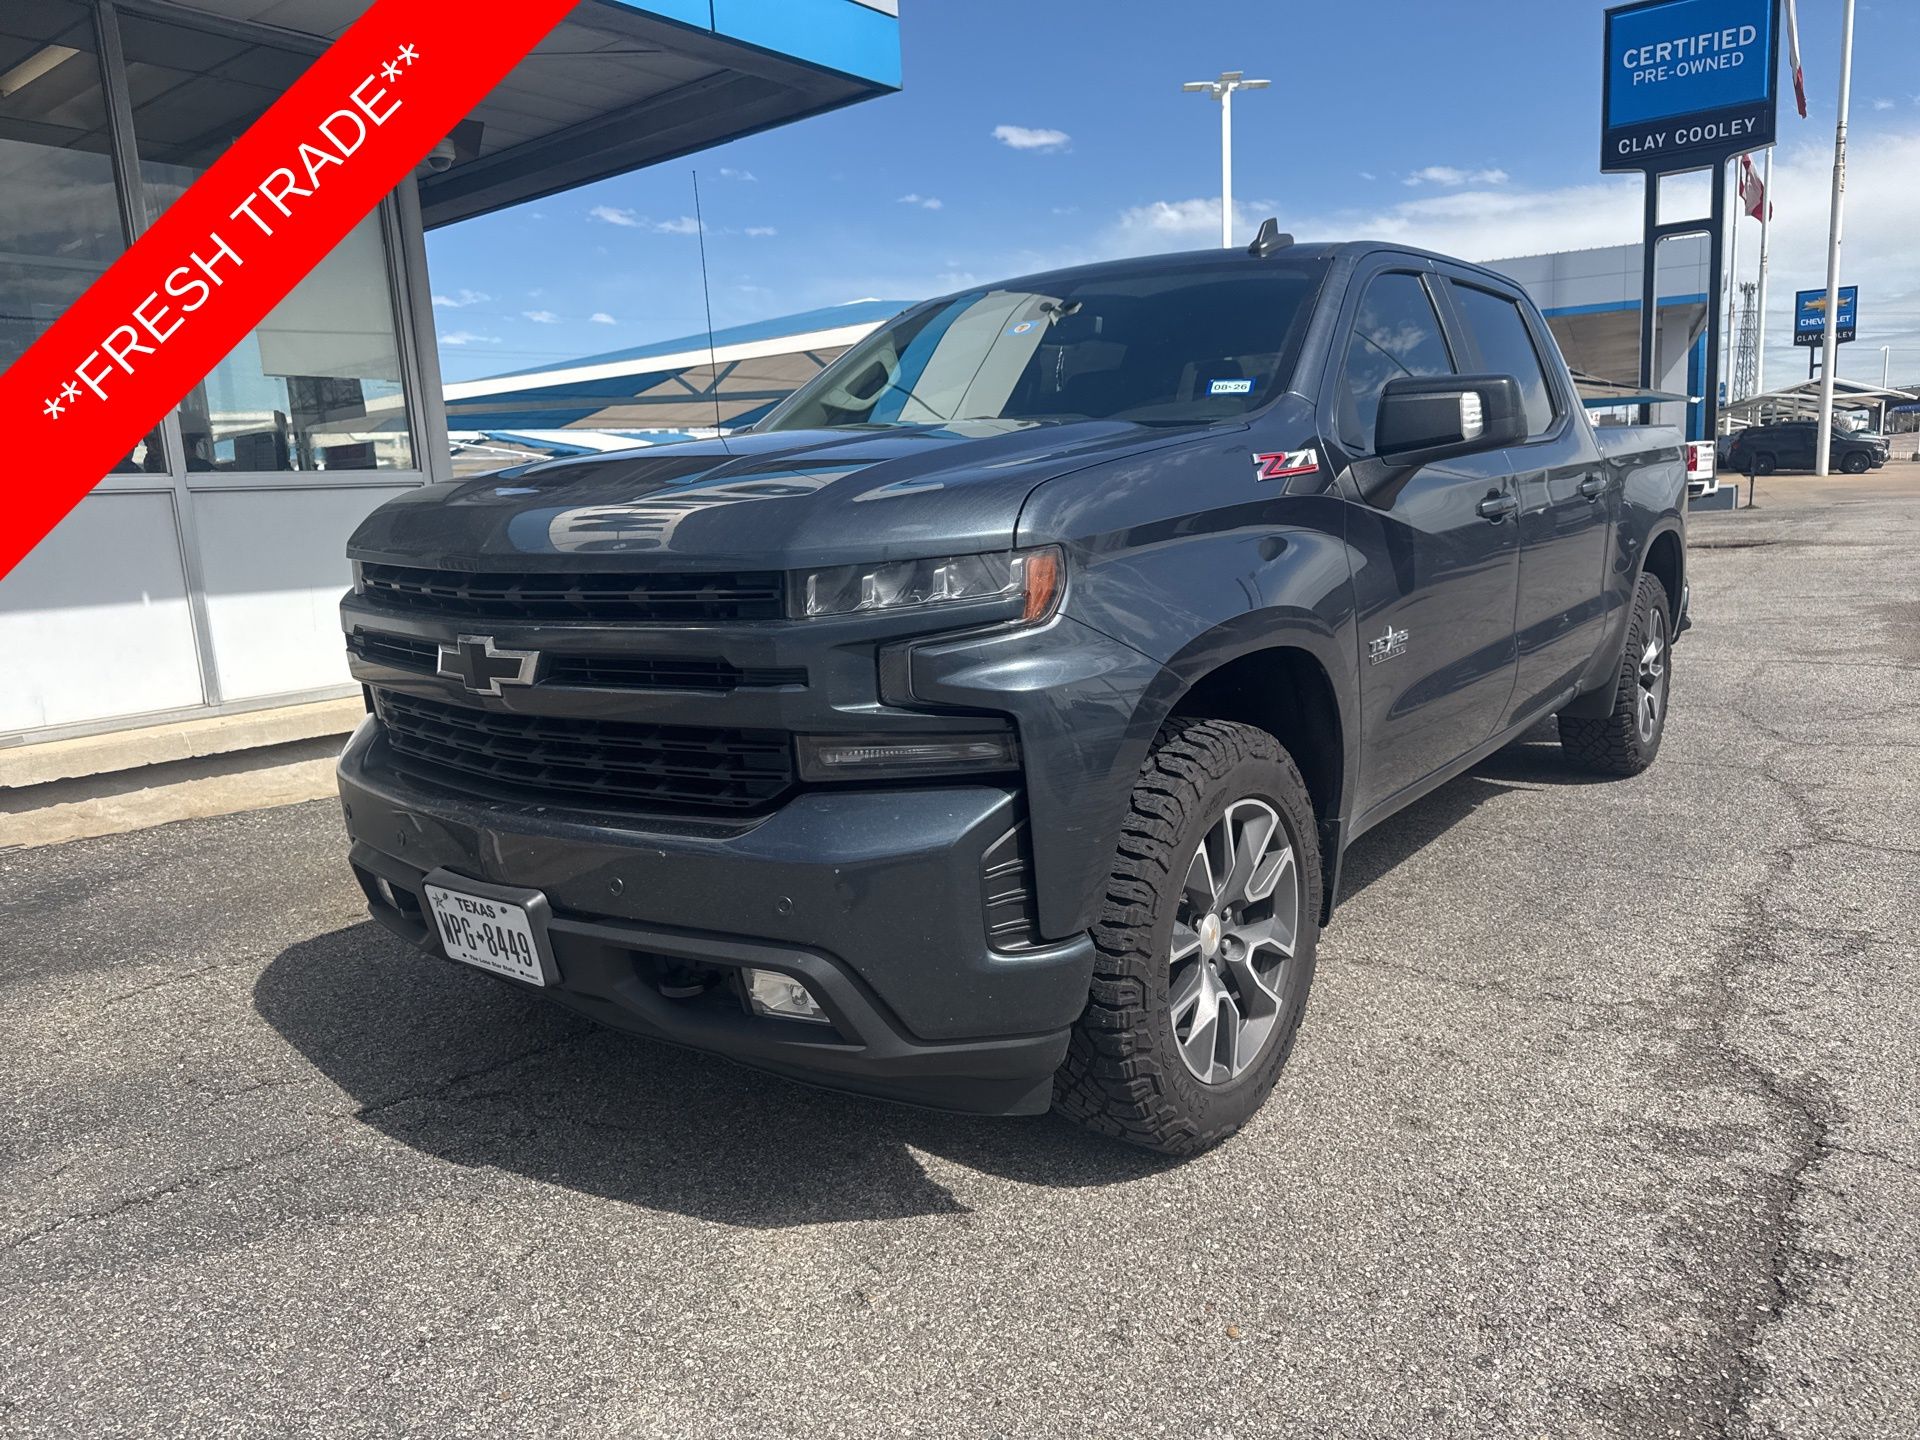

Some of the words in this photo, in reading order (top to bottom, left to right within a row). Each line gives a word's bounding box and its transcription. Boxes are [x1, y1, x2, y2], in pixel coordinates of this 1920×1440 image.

[1623, 25, 1757, 69] CERTIFIED
[1633, 51, 1744, 86] PRE-OWNED
[1618, 133, 1667, 155] CLAY
[1675, 117, 1757, 145] COOLEY
[1796, 334, 1818, 342] CLAY
[1820, 331, 1853, 340] CLEY
[1800, 315, 1851, 326] CHEVET
[1213, 383, 1248, 391] 08-26
[1252, 448, 1320, 482] Z71
[455, 896, 496, 919] TEXAS
[482, 922, 533, 967] 8449
